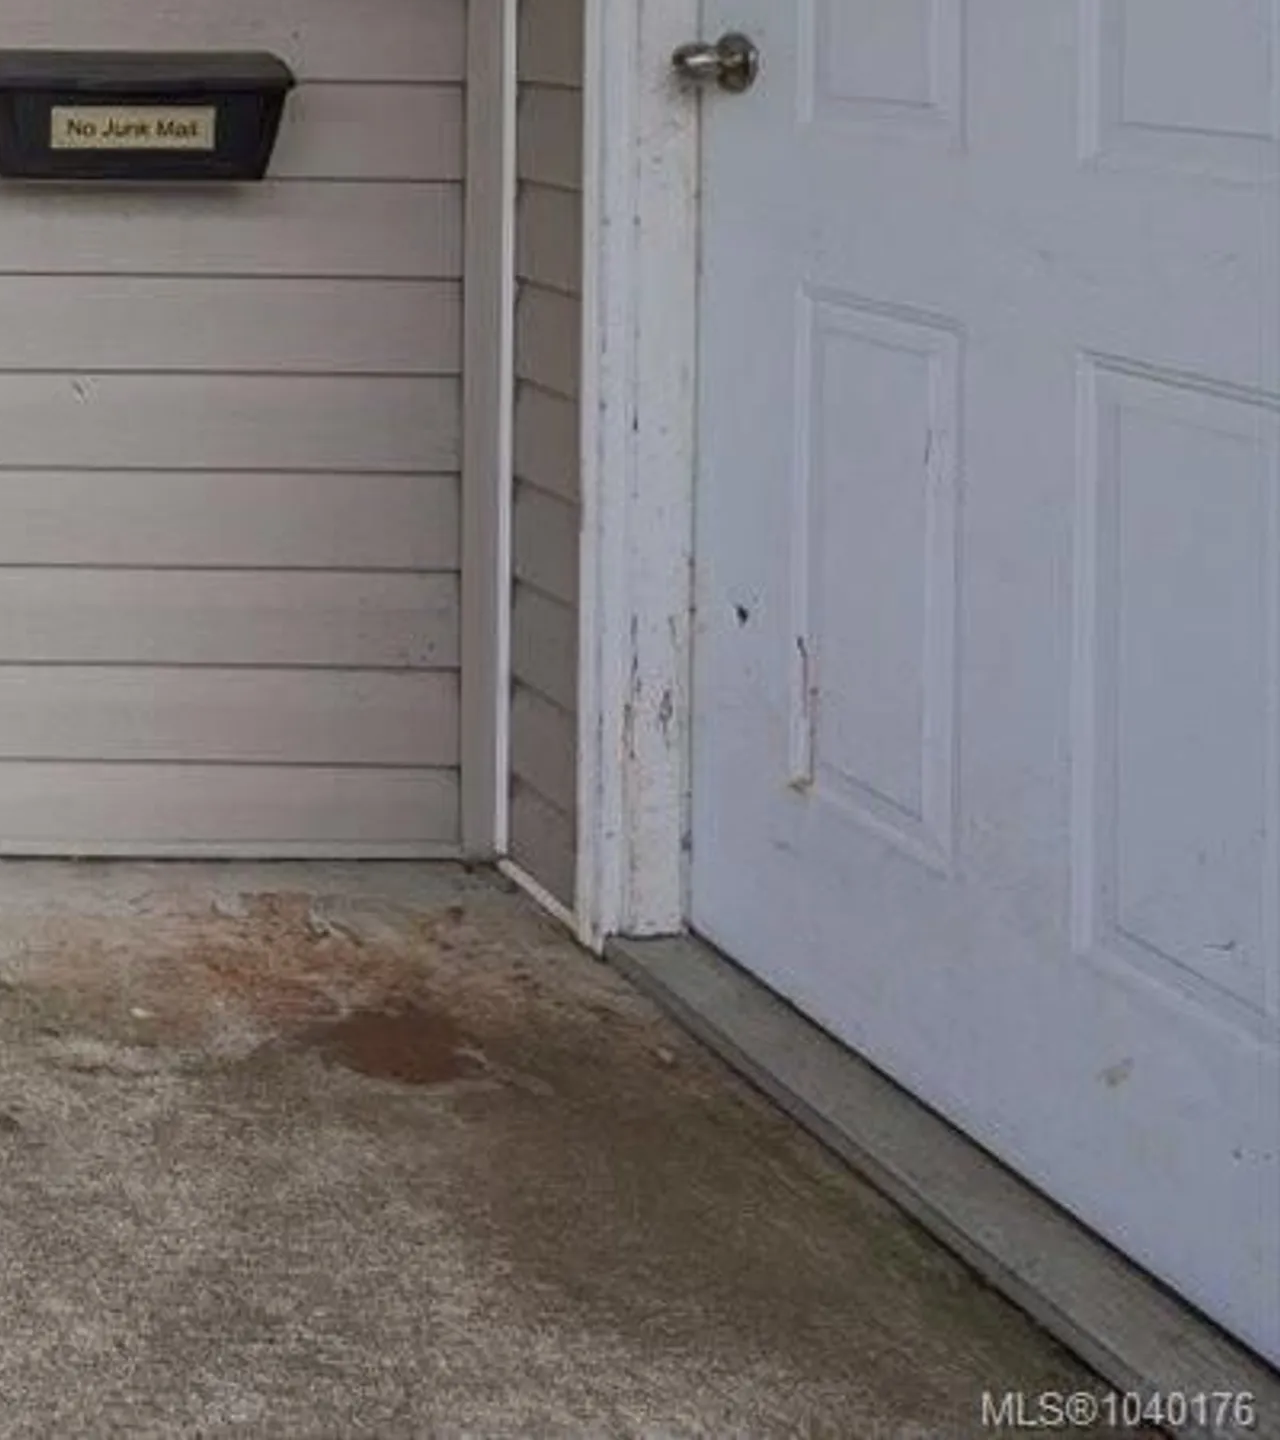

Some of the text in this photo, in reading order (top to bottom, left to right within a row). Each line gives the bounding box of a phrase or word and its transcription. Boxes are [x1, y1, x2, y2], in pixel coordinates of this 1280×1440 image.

[66, 116, 198, 138] No Junk Mail
